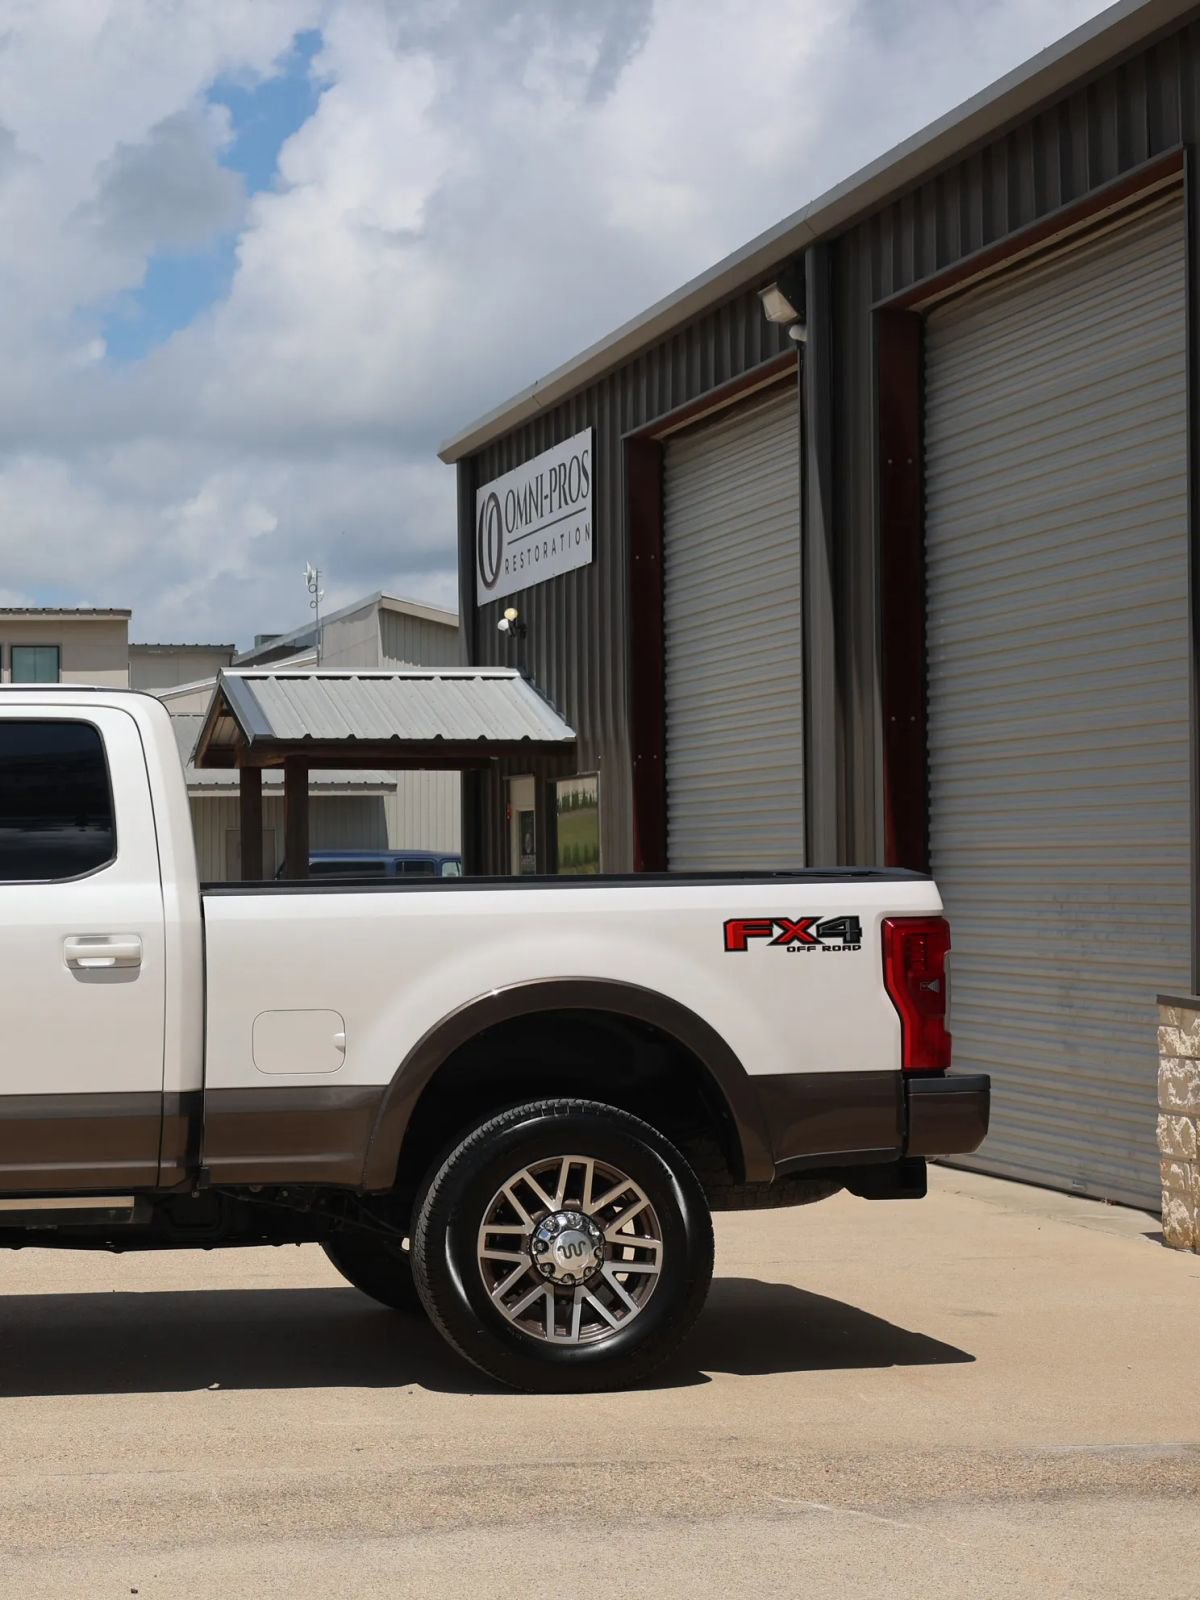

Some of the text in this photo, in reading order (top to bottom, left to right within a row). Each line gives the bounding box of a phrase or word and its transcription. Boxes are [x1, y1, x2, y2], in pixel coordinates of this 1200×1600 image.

[504, 449, 590, 534] OMNI-PROS
[504, 522, 591, 574] RESTORATION
[723, 915, 863, 953] FX4
[786, 944, 862, 953] OFF ROAD
